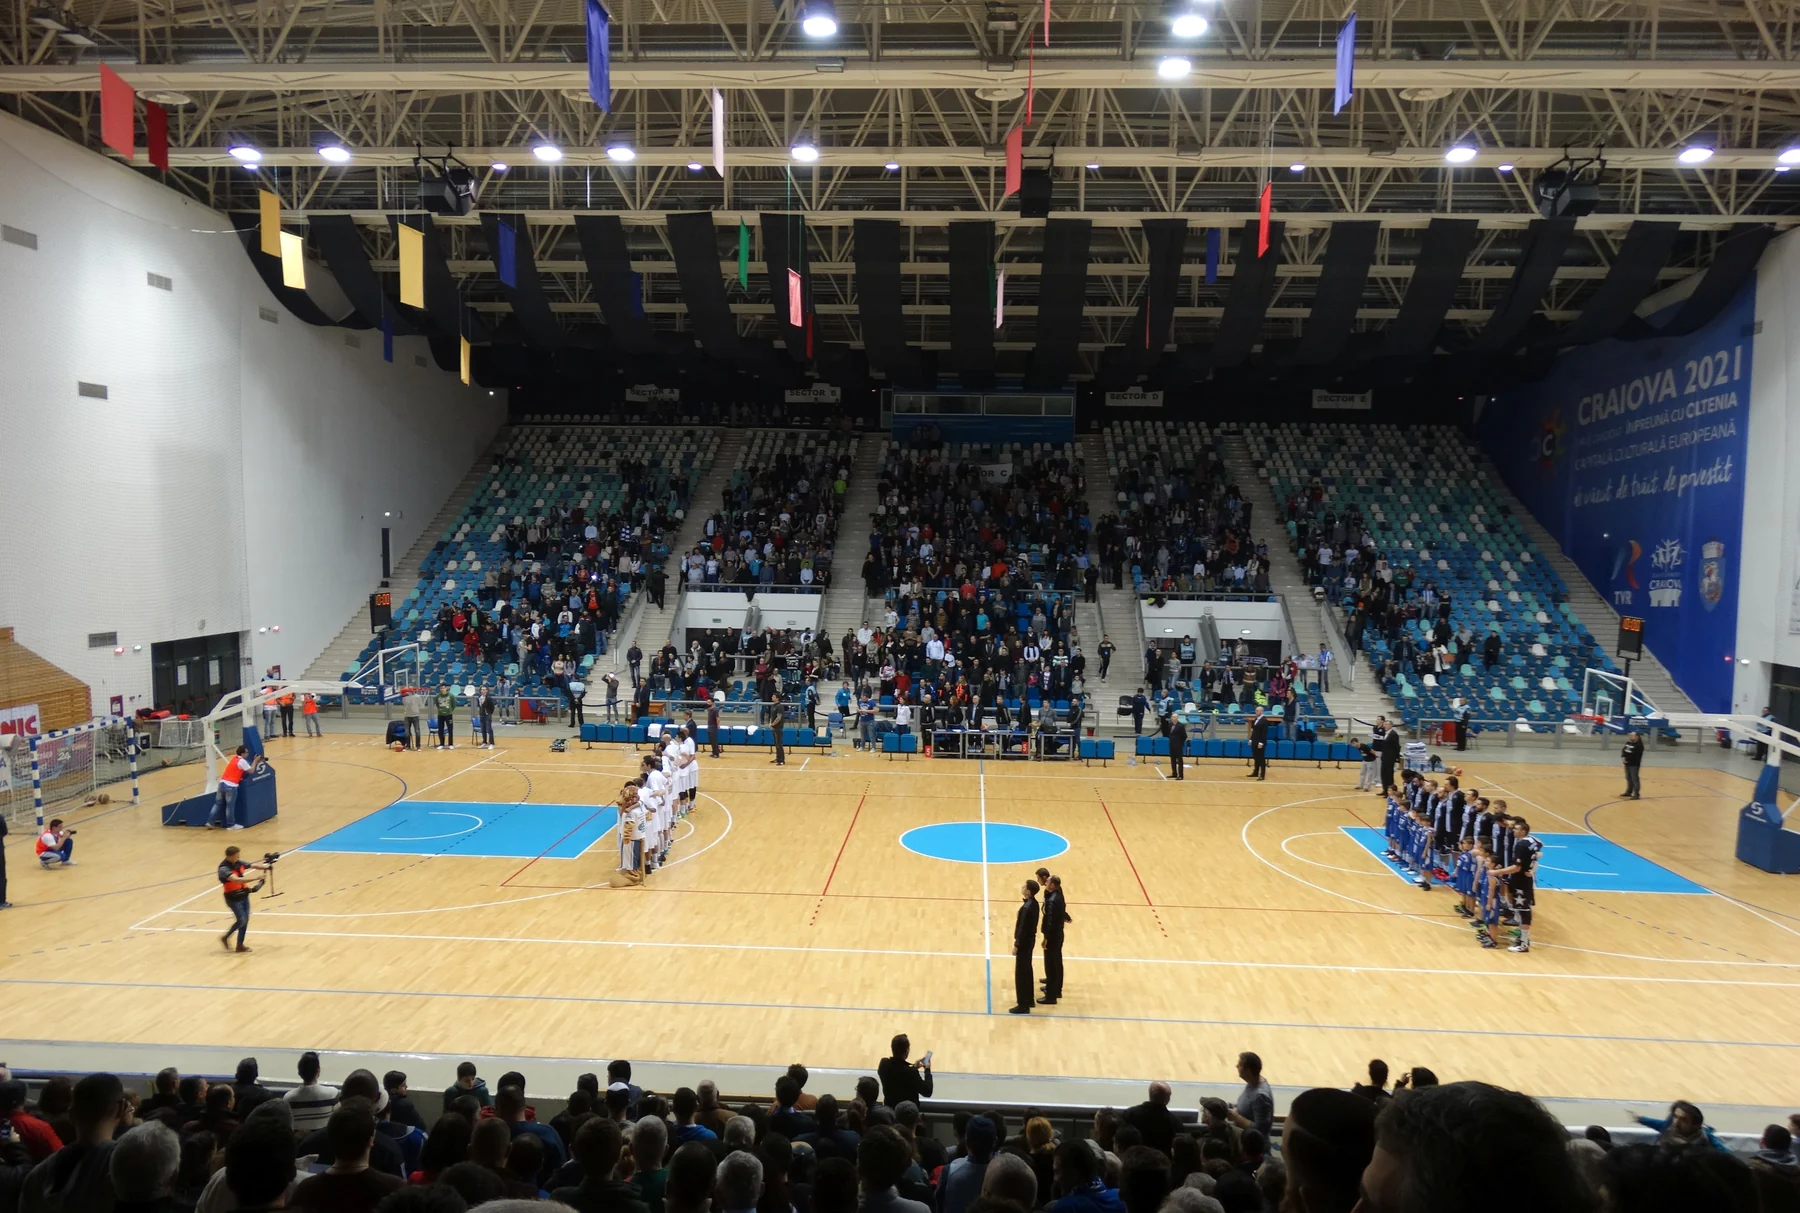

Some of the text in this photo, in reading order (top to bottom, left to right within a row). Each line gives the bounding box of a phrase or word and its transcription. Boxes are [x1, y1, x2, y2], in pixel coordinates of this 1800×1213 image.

[1578, 345, 1742, 425] CRAIOVA 2021
[630, 388, 664, 396] SECTOR
[789, 389, 837, 397] SECTOR B
[1110, 392, 1159, 400] SECTOR D
[1000, 469, 1007, 477] C
[1663, 465, 1677, 492] de
[1614, 590, 1632, 605] TVR
